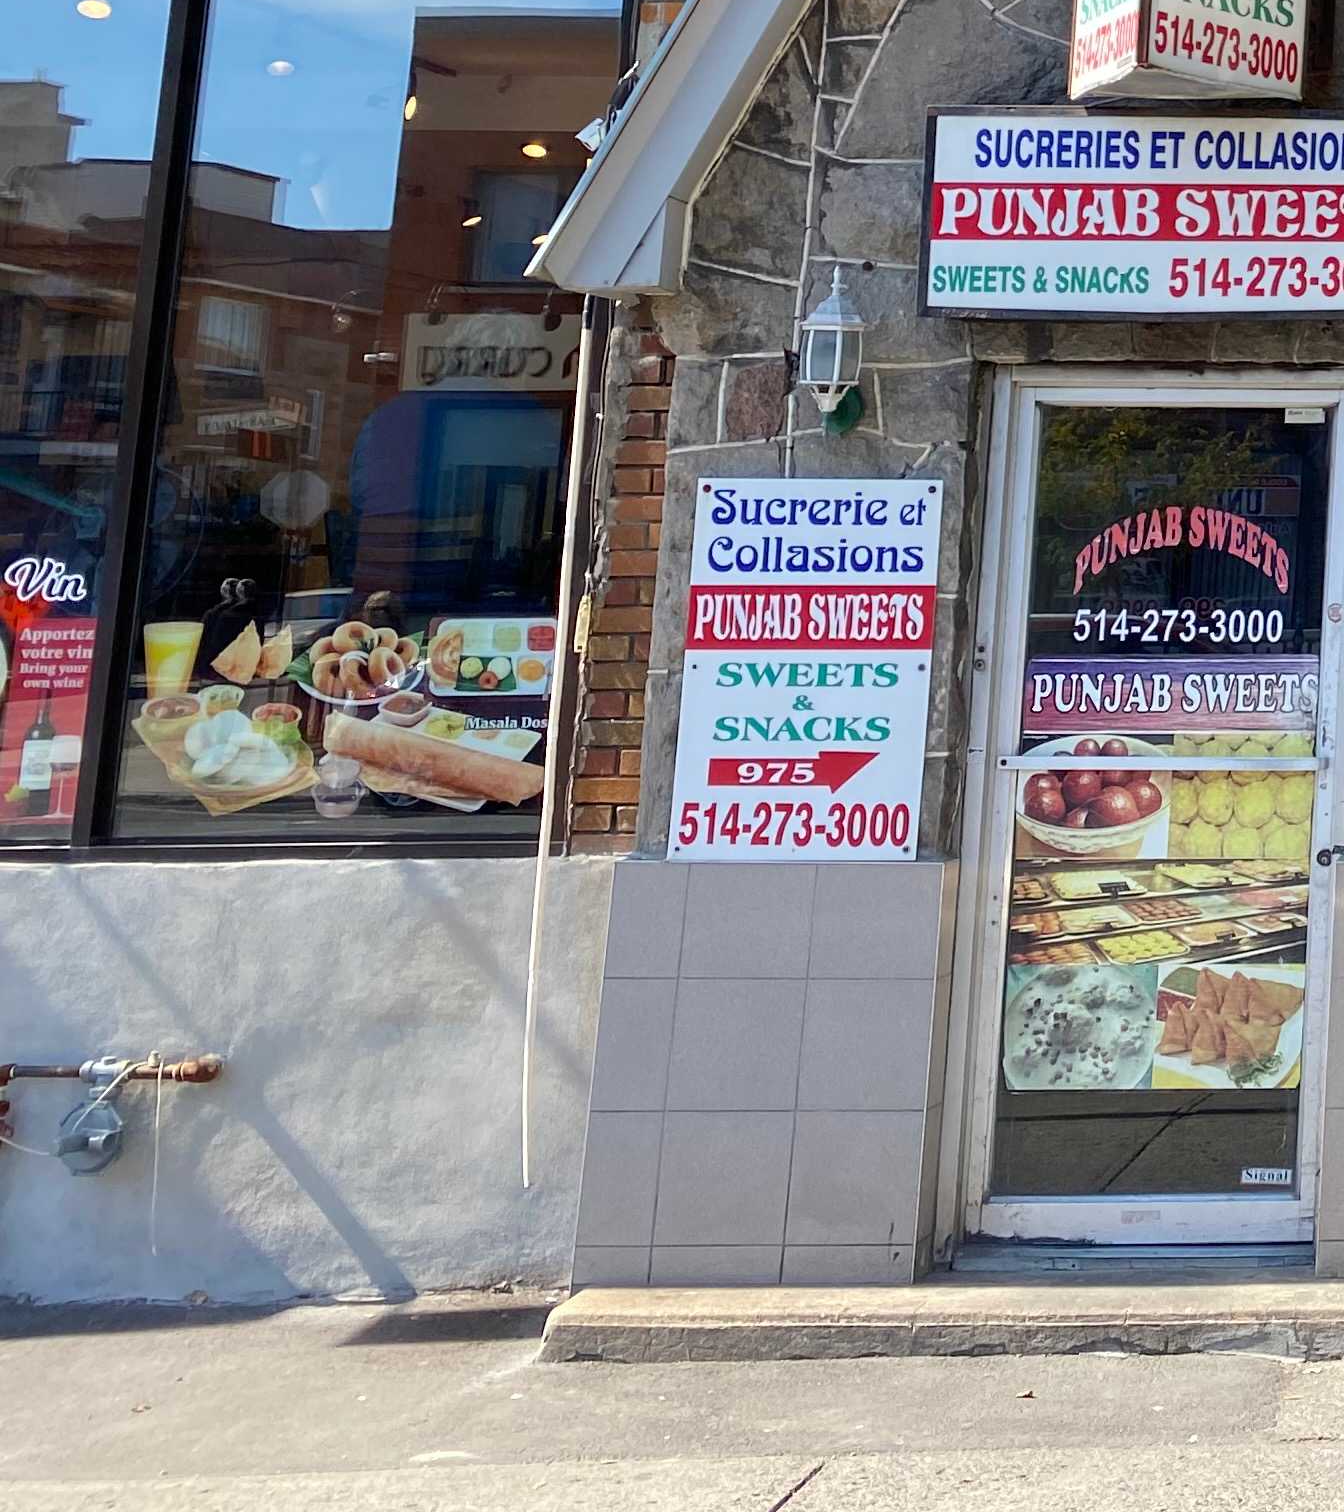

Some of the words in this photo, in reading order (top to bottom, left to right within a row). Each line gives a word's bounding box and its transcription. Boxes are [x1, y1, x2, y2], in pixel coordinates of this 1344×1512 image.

[1154, 11, 1298, 85] 514-273-3000
[975, 129, 1140, 171] SUCRERIES
[1150, 131, 1186, 170] ET
[937, 187, 1161, 237] PUNJAB
[933, 265, 1026, 294] SWEETS
[1033, 266, 1048, 294] &
[1055, 266, 1150, 295] SNACKS
[711, 490, 888, 526] Sucrerie
[899, 497, 927, 526] et
[707, 536, 925, 573] Collasions
[1072, 506, 1183, 596] PUNJAB
[1188, 506, 1290, 595] SWEETS
[4, 558, 87, 602] Vin
[693, 593, 802, 642] PUNJAB
[808, 593, 925, 642] SWEETS
[1072, 608, 1284, 644] 514-273-3000
[19, 628, 95, 643] Apportez
[21, 647, 63, 659] votre
[67, 644, 93, 659] vin
[19, 663, 56, 676] Bring
[52, 675, 84, 688] wine
[716, 662, 899, 688] SWEETS
[792, 694, 814, 711] &
[1031, 672, 1174, 713] PUNJAB
[1181, 672, 1319, 716] SWEETS
[464, 716, 518, 729] Masala
[520, 716, 549, 729] Dos
[712, 716, 891, 742] SNACKS
[736, 762, 816, 785] 975
[678, 802, 911, 848] 514-273-3000
[1245, 1168, 1288, 1182] Signal
